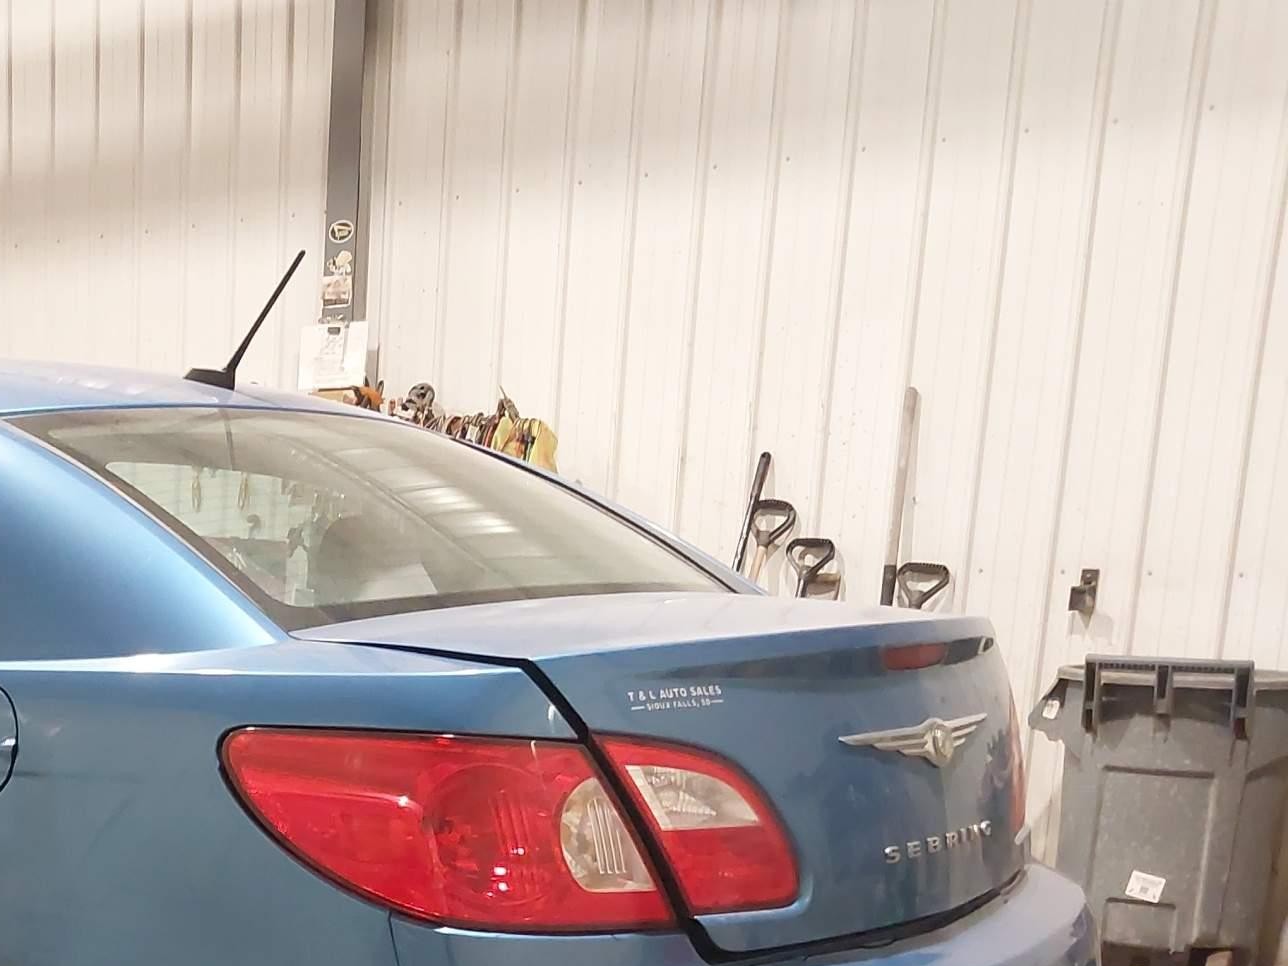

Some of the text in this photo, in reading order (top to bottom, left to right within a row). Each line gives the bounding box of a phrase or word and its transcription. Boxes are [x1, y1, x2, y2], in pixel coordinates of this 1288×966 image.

[627, 684, 722, 702] T & L AUTO SALES
[884, 820, 992, 865] SEBRING
